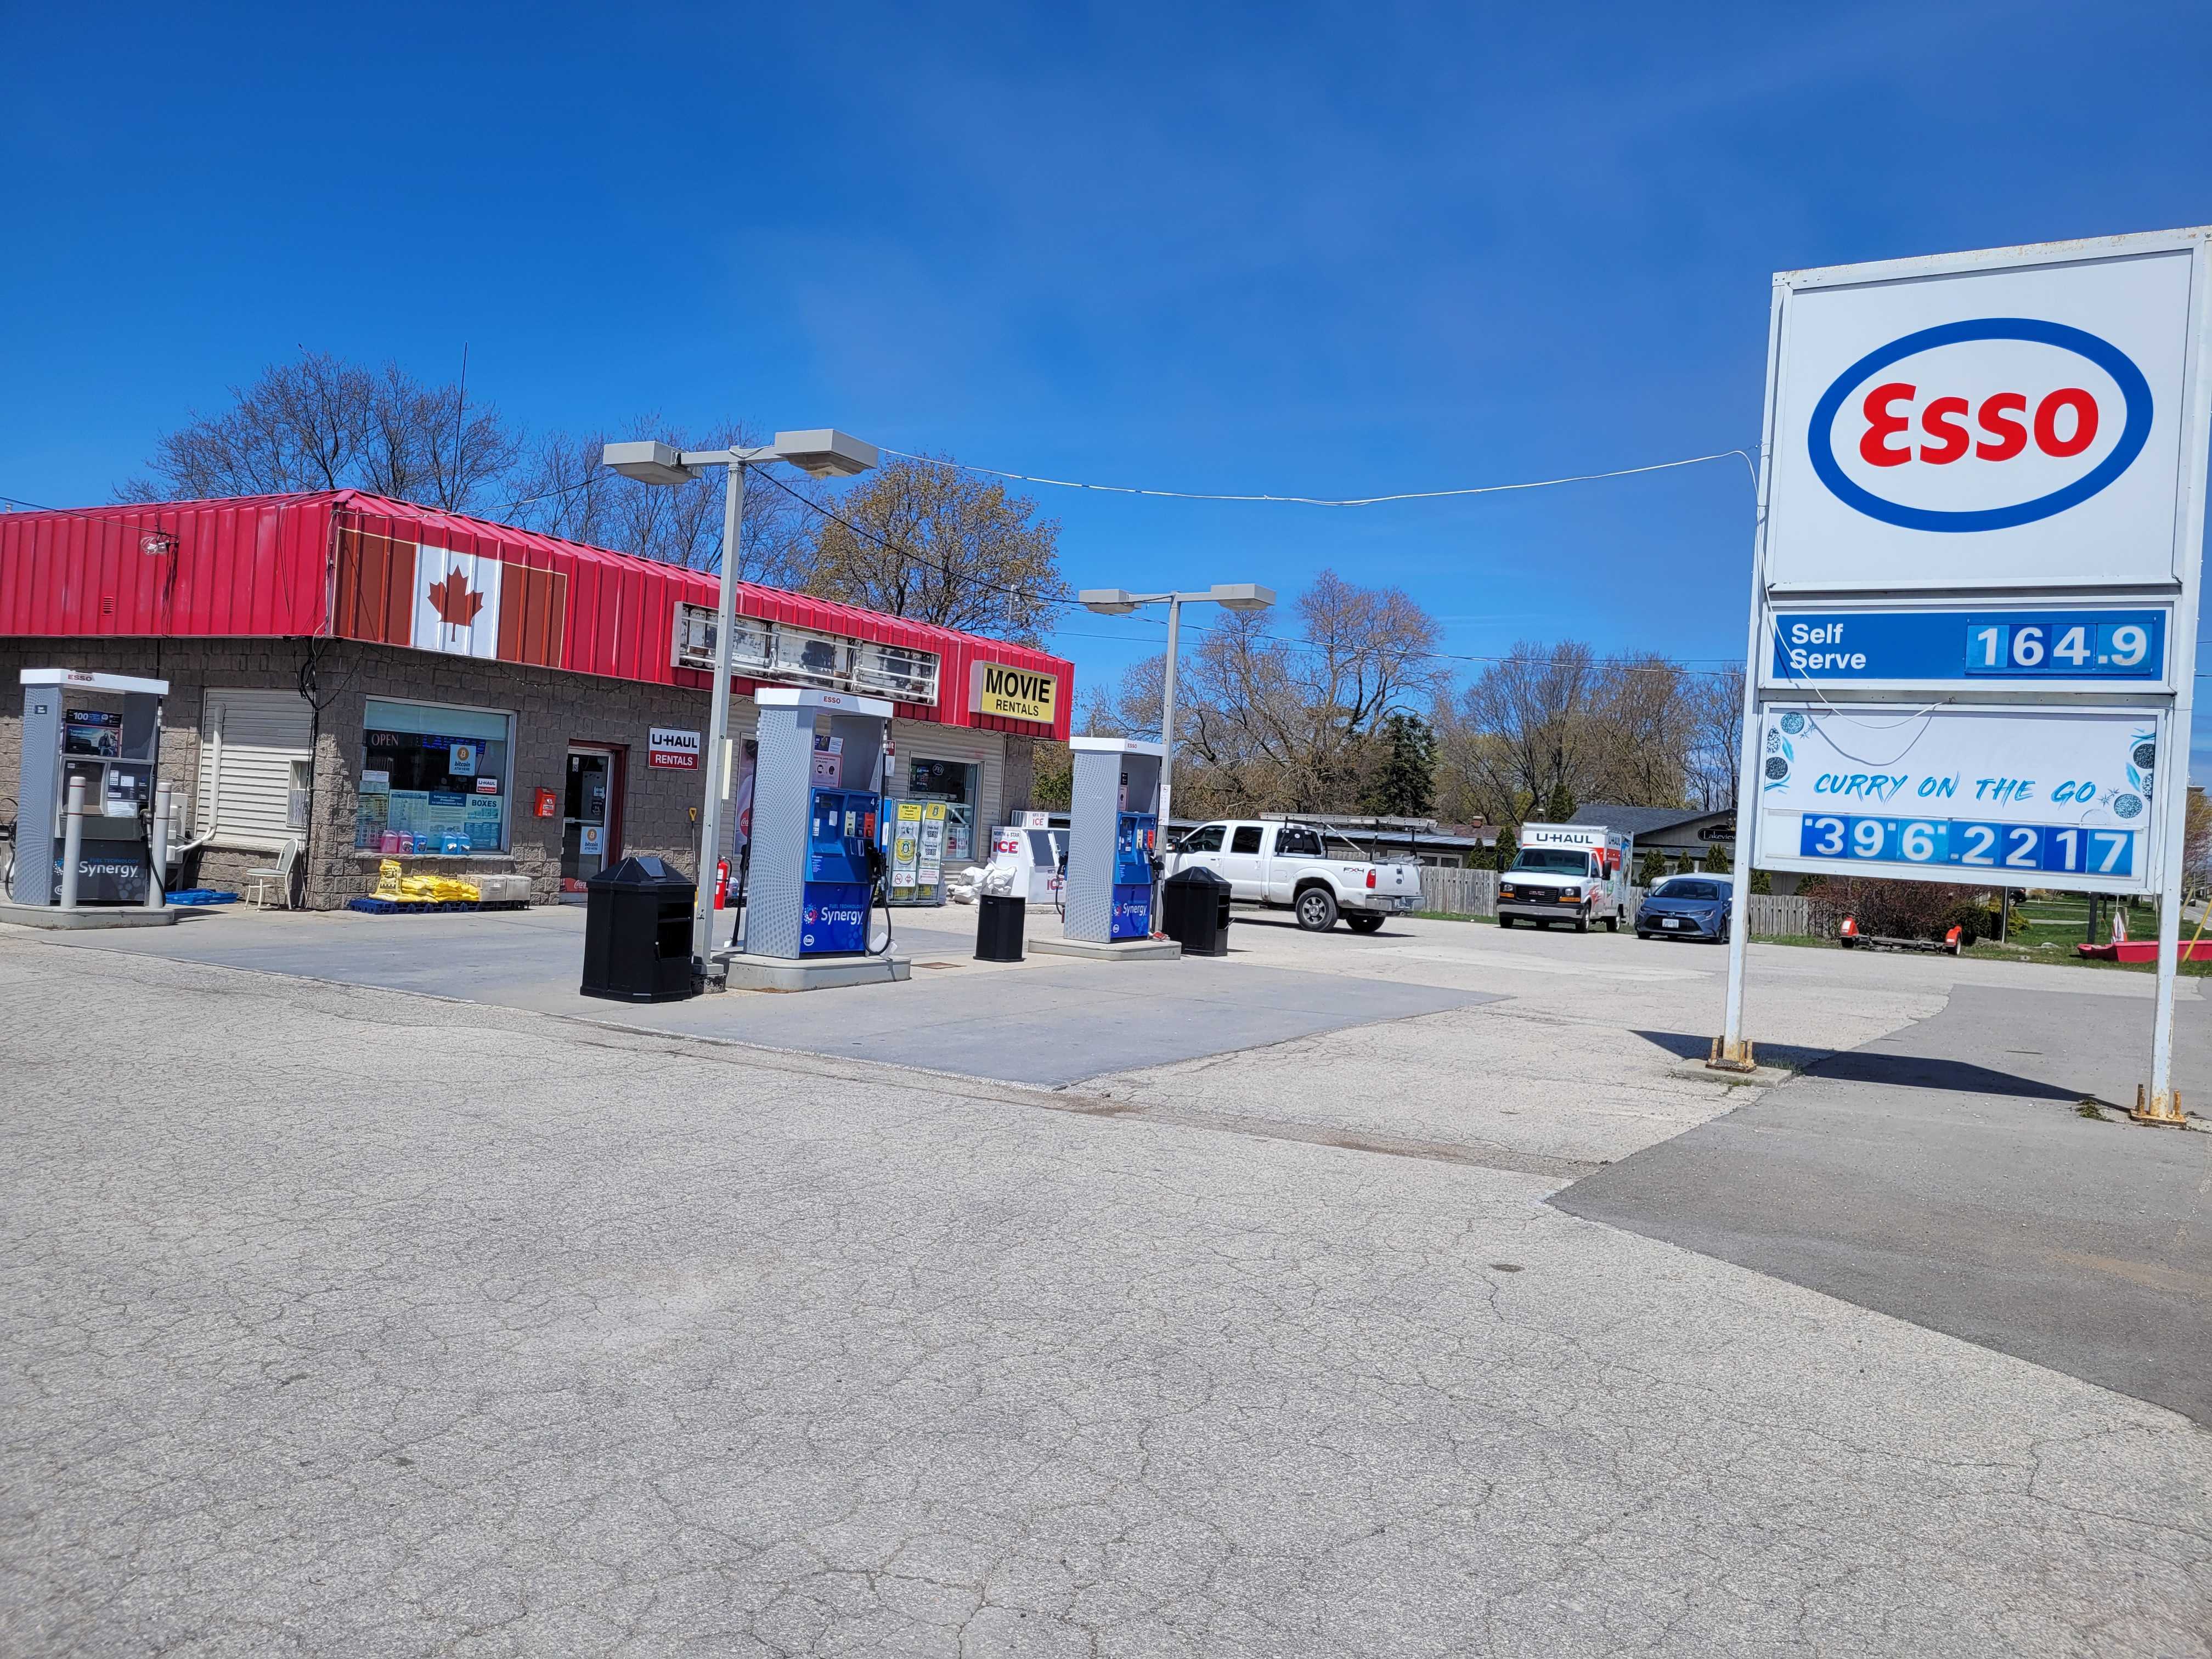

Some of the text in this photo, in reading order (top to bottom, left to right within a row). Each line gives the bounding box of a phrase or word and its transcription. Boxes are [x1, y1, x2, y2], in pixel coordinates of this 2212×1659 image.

[1860, 382, 2099, 467] Esso
[1791, 623, 1844, 644] Self
[1978, 626, 2147, 666] 164.9
[1790, 648, 1866, 669] Serve
[986, 668, 1051, 703] MOVIE
[996, 699, 1039, 716] RENTALS
[371, 733, 399, 746] OPEN
[652, 733, 698, 748] U-HAUL
[655, 754, 693, 766] RENTALS
[1814, 771, 2097, 809] CURRY ON THE GO
[870, 798, 875, 806] 4
[993, 839, 1019, 854] ICE
[1536, 833, 1593, 844] U-HAUL
[79, 861, 138, 877] Synergy
[1047, 877, 1064, 890] ICE
[821, 907, 864, 925] Synergy
[1122, 903, 1147, 917] Synergy
